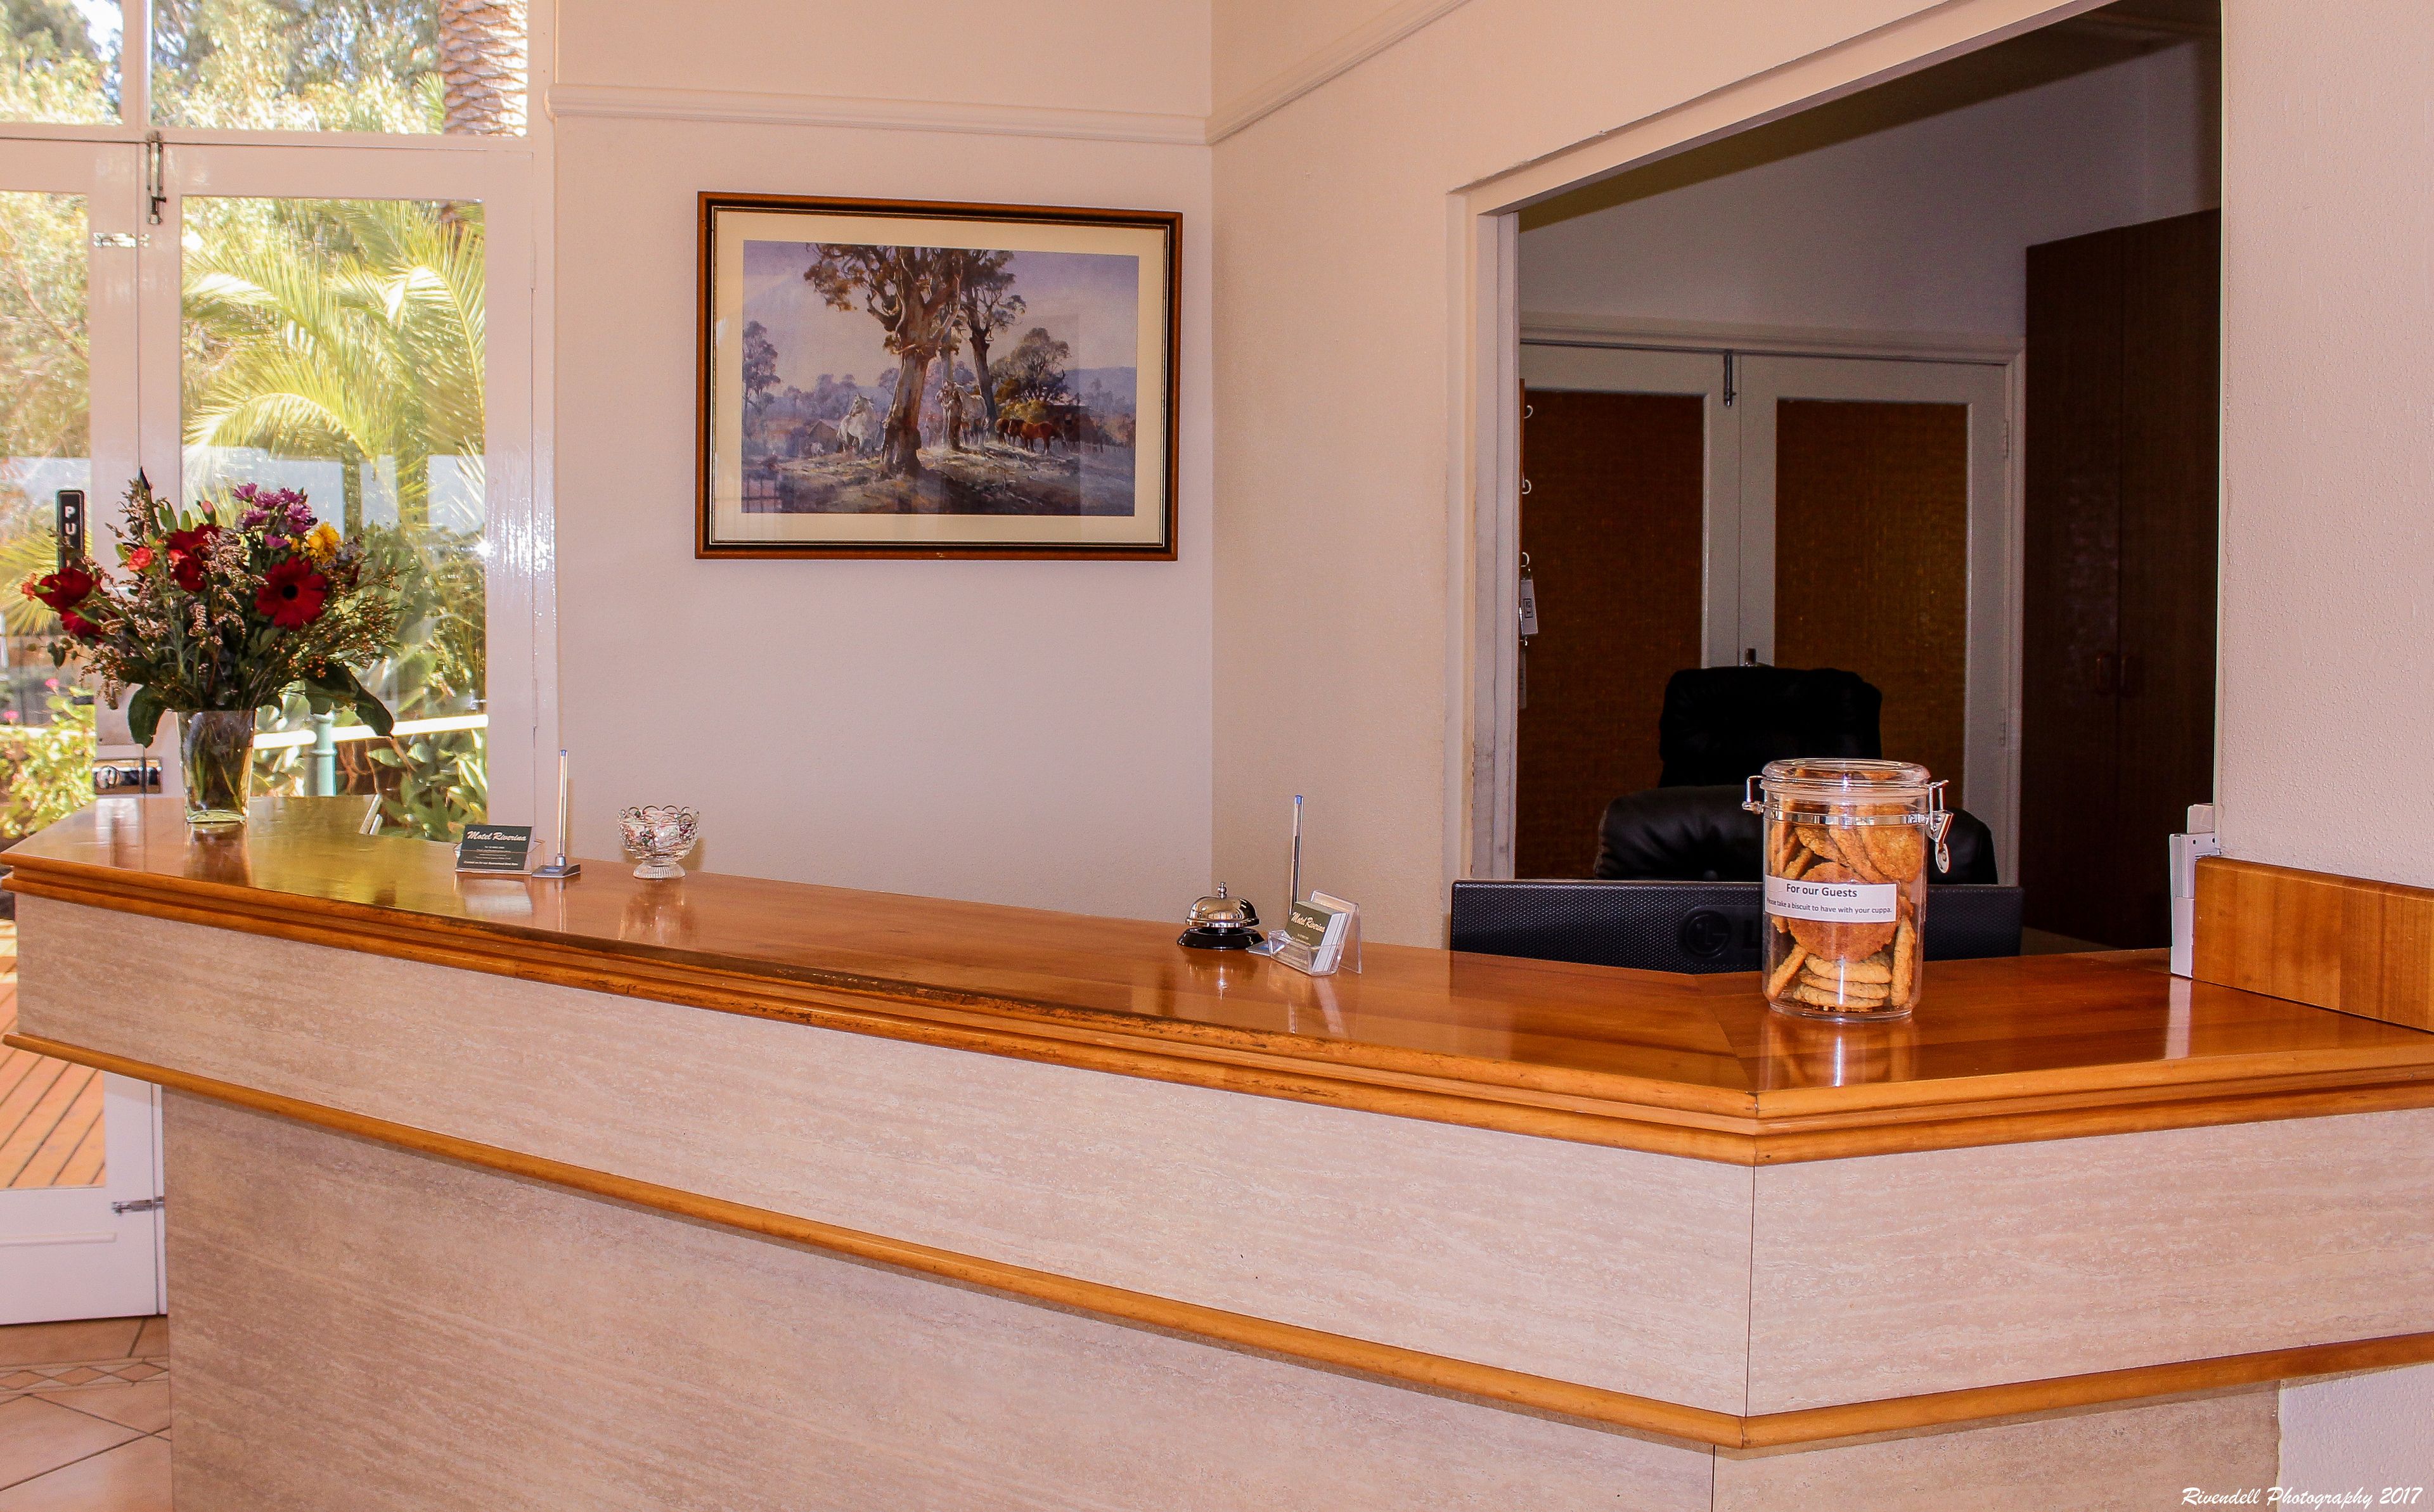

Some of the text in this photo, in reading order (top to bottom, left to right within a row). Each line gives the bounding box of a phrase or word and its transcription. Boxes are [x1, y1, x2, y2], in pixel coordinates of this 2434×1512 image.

[467, 831, 493, 840] Motel
[1786, 883, 1858, 897] For our Guests
[1791, 902, 1810, 911] biscuit
[1291, 912, 1307, 926] Motel
